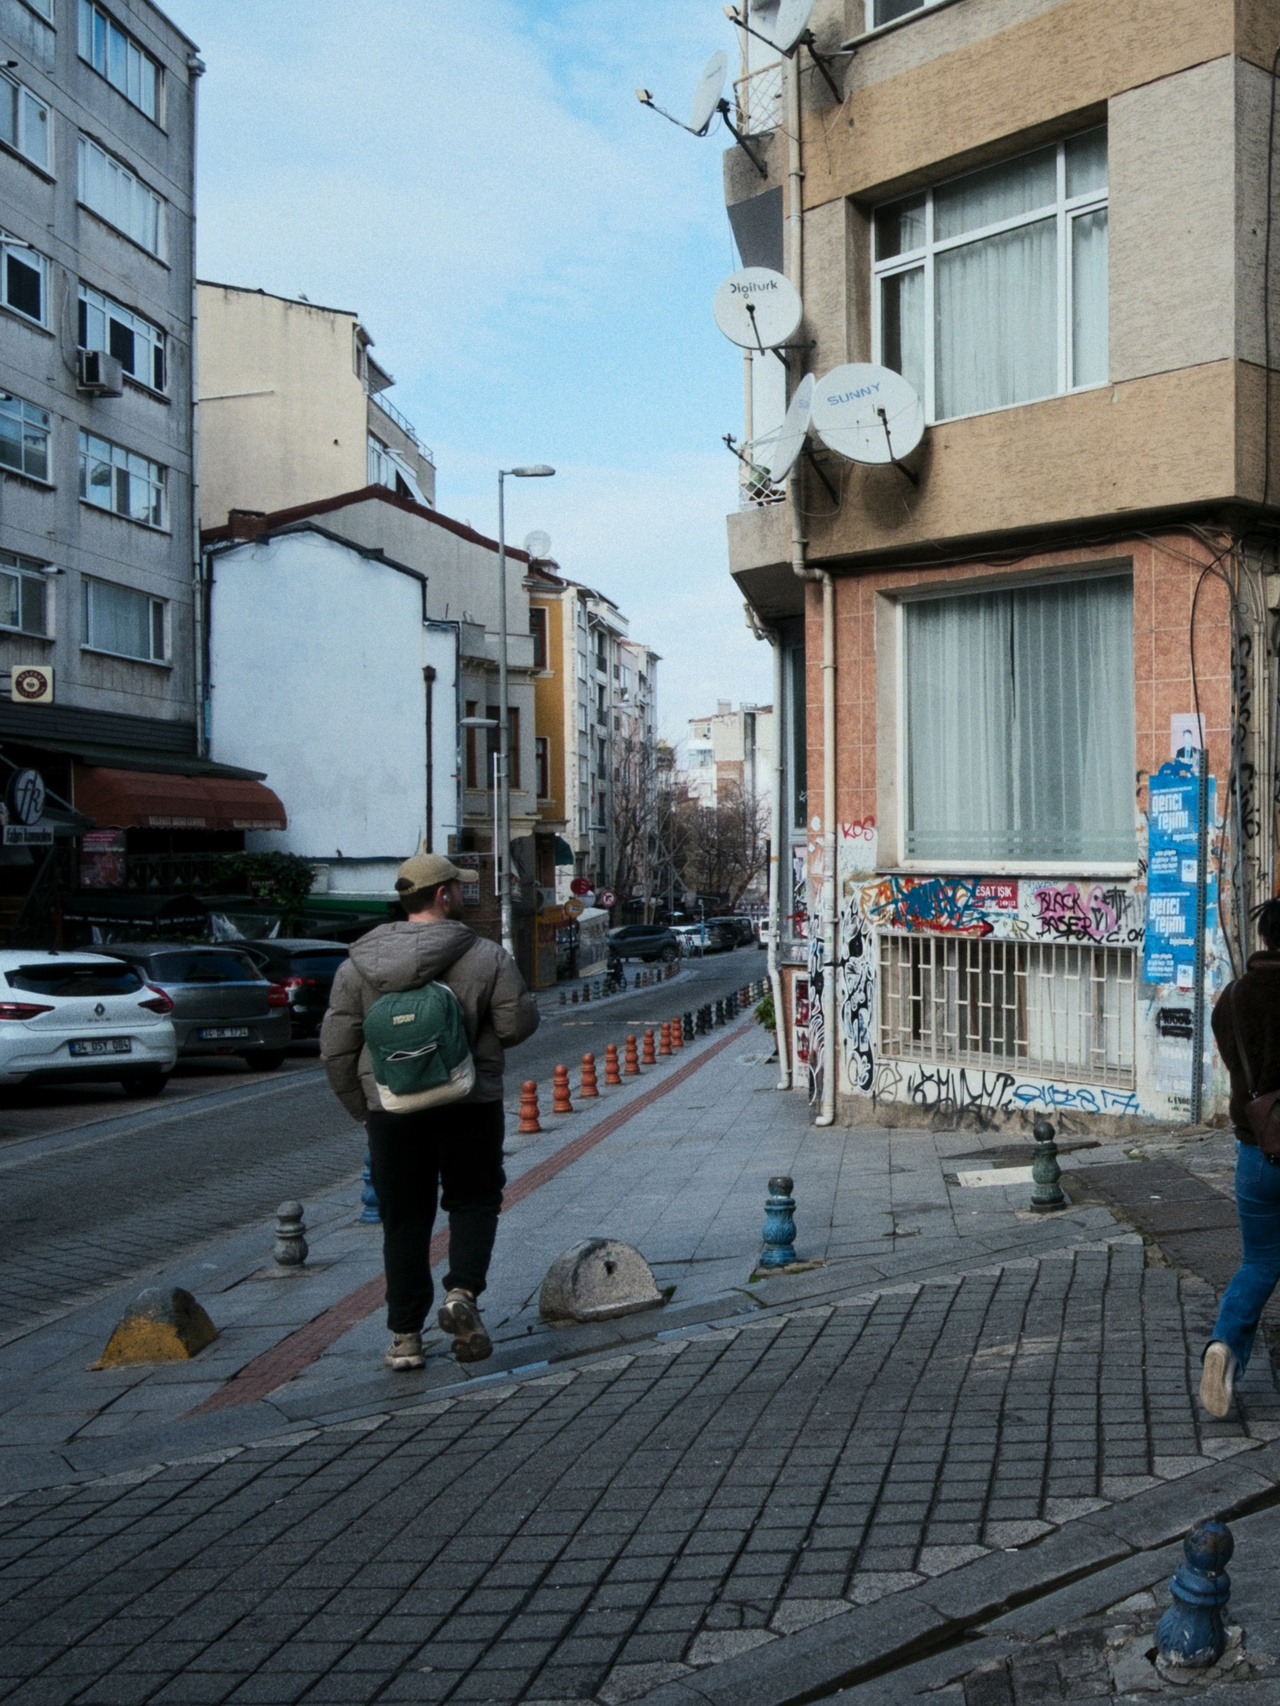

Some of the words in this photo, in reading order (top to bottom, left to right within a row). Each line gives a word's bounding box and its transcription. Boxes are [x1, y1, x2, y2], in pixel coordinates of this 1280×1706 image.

[827, 382, 880, 406] SUNNY
[976, 885, 995, 897] ESAT
[997, 886, 1012, 898] IŞIK
[76, 1042, 86, 1052] 34
